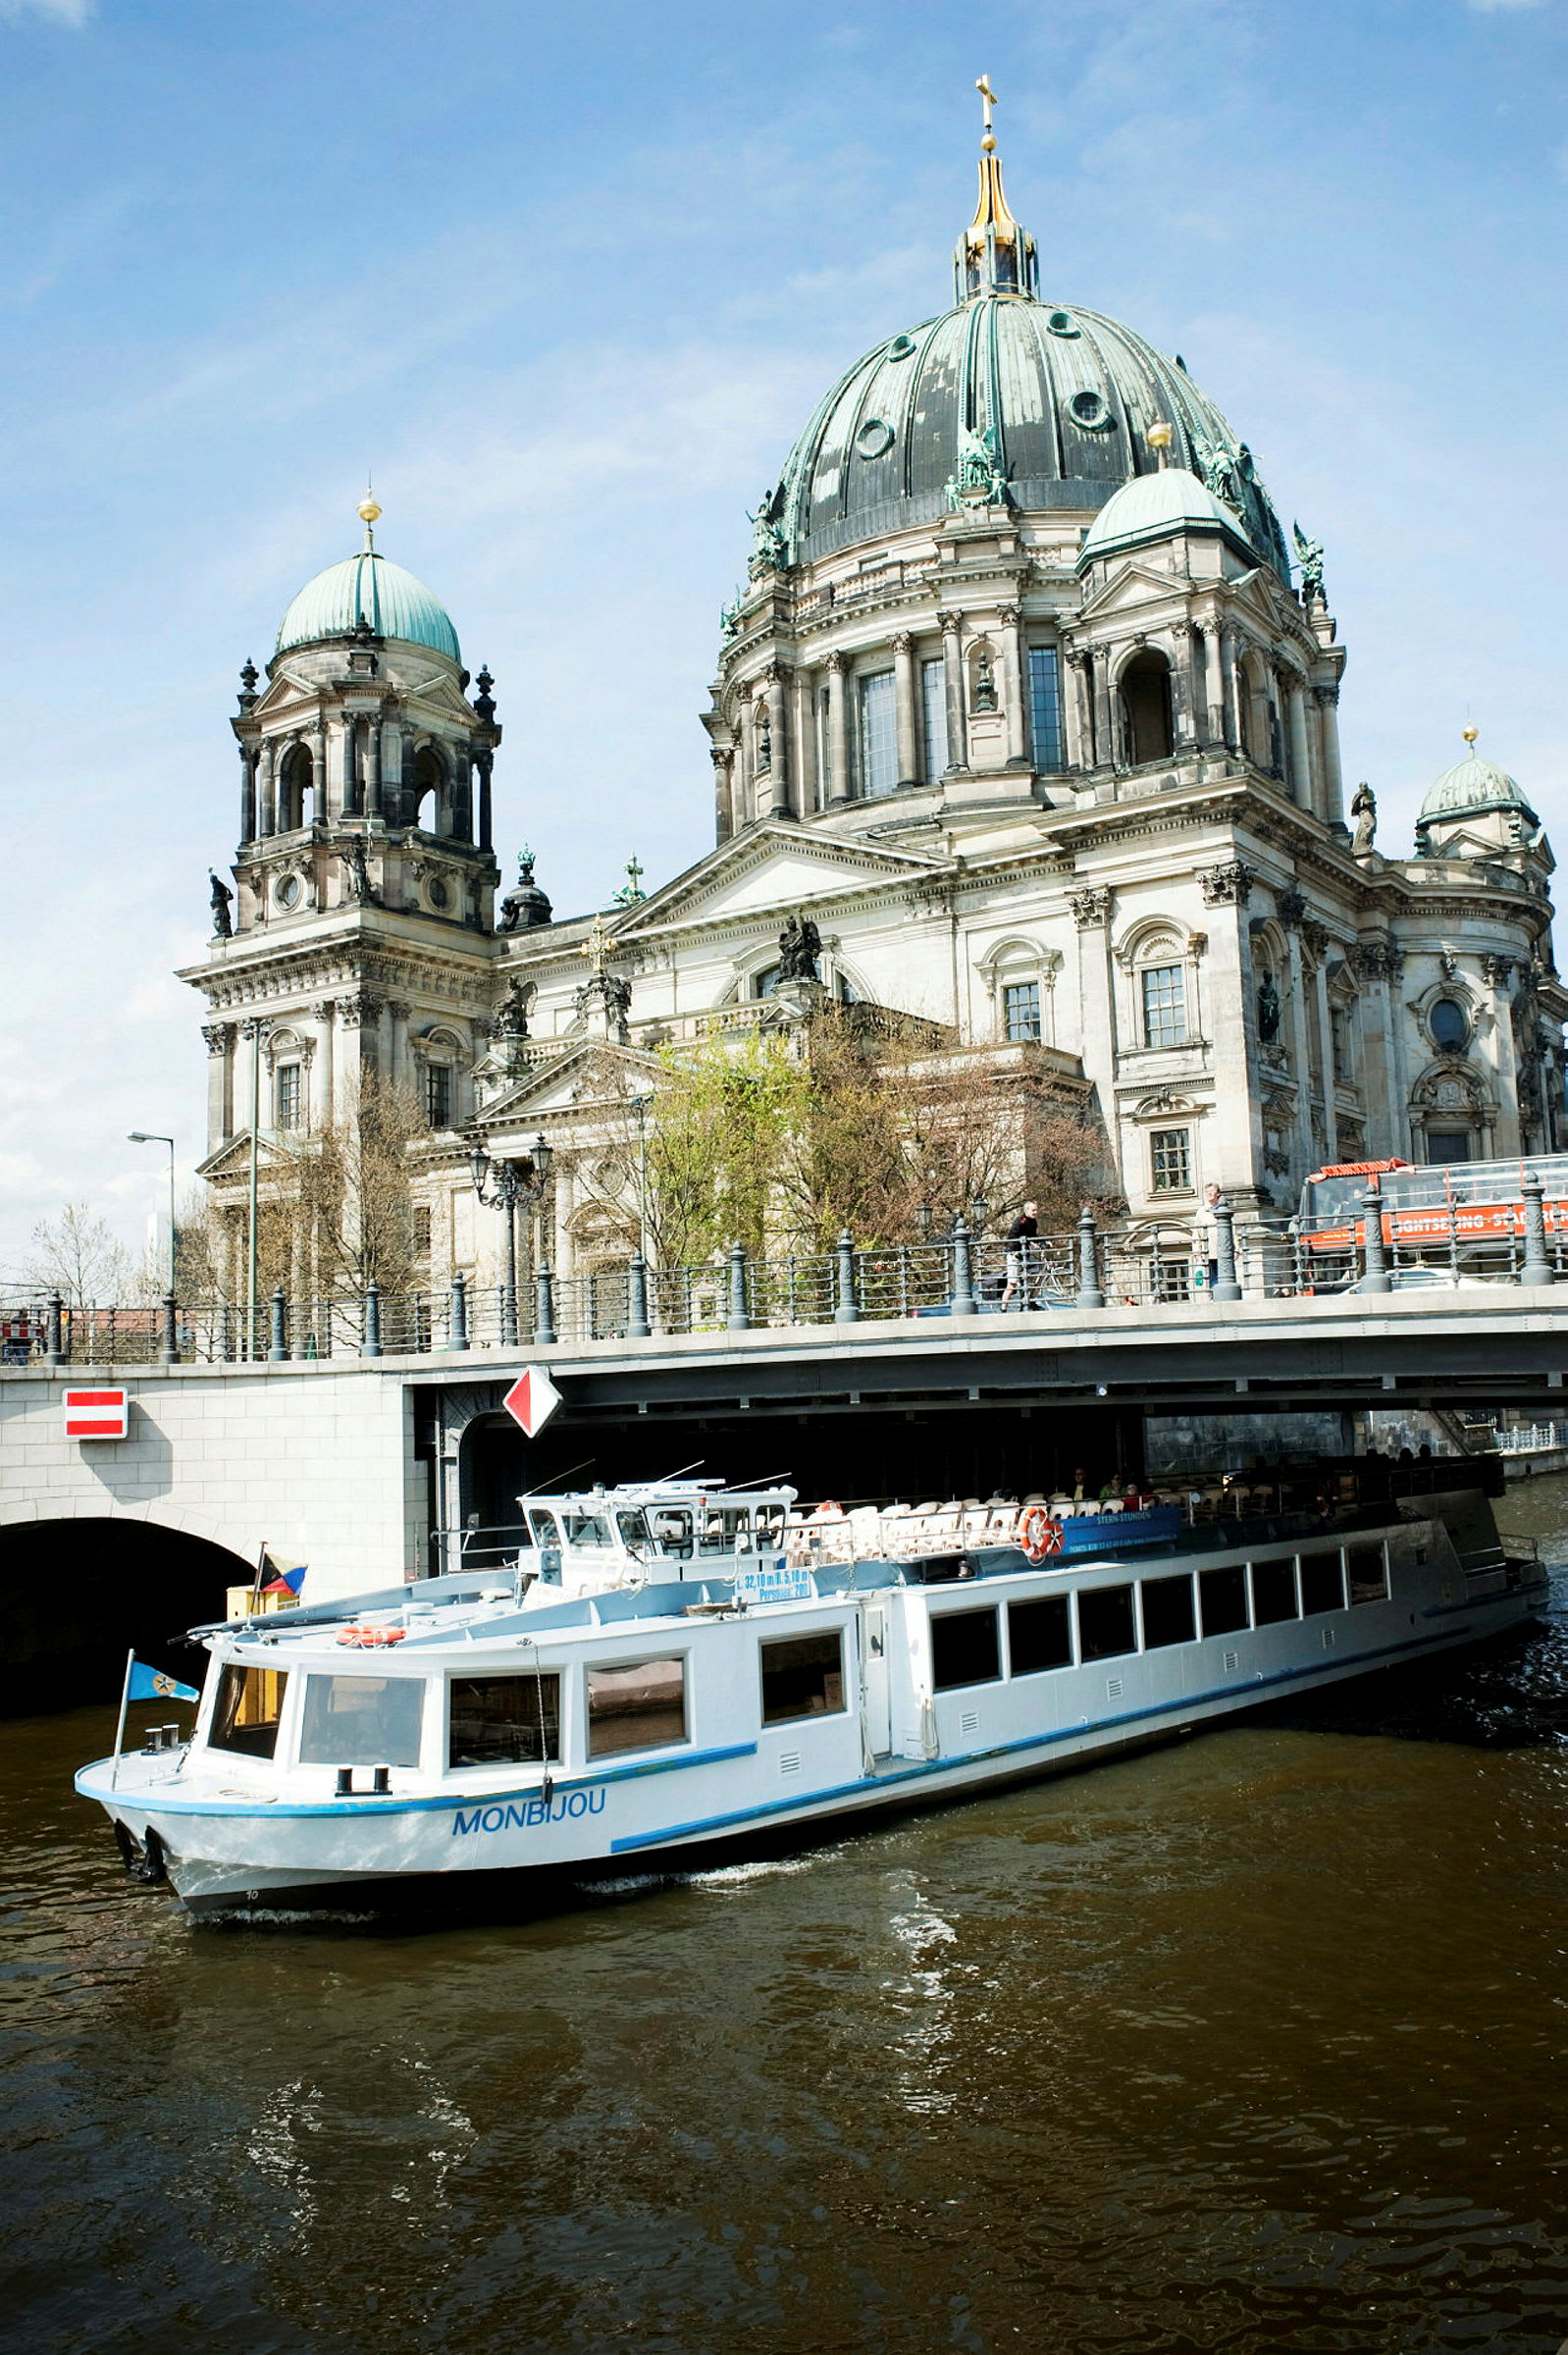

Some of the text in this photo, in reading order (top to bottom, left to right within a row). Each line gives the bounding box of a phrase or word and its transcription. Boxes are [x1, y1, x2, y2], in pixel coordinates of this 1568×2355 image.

[745, 1573, 765, 1591] 32,10
[767, 1575, 773, 1586] m
[452, 1788, 606, 1836] MONBIJOU
